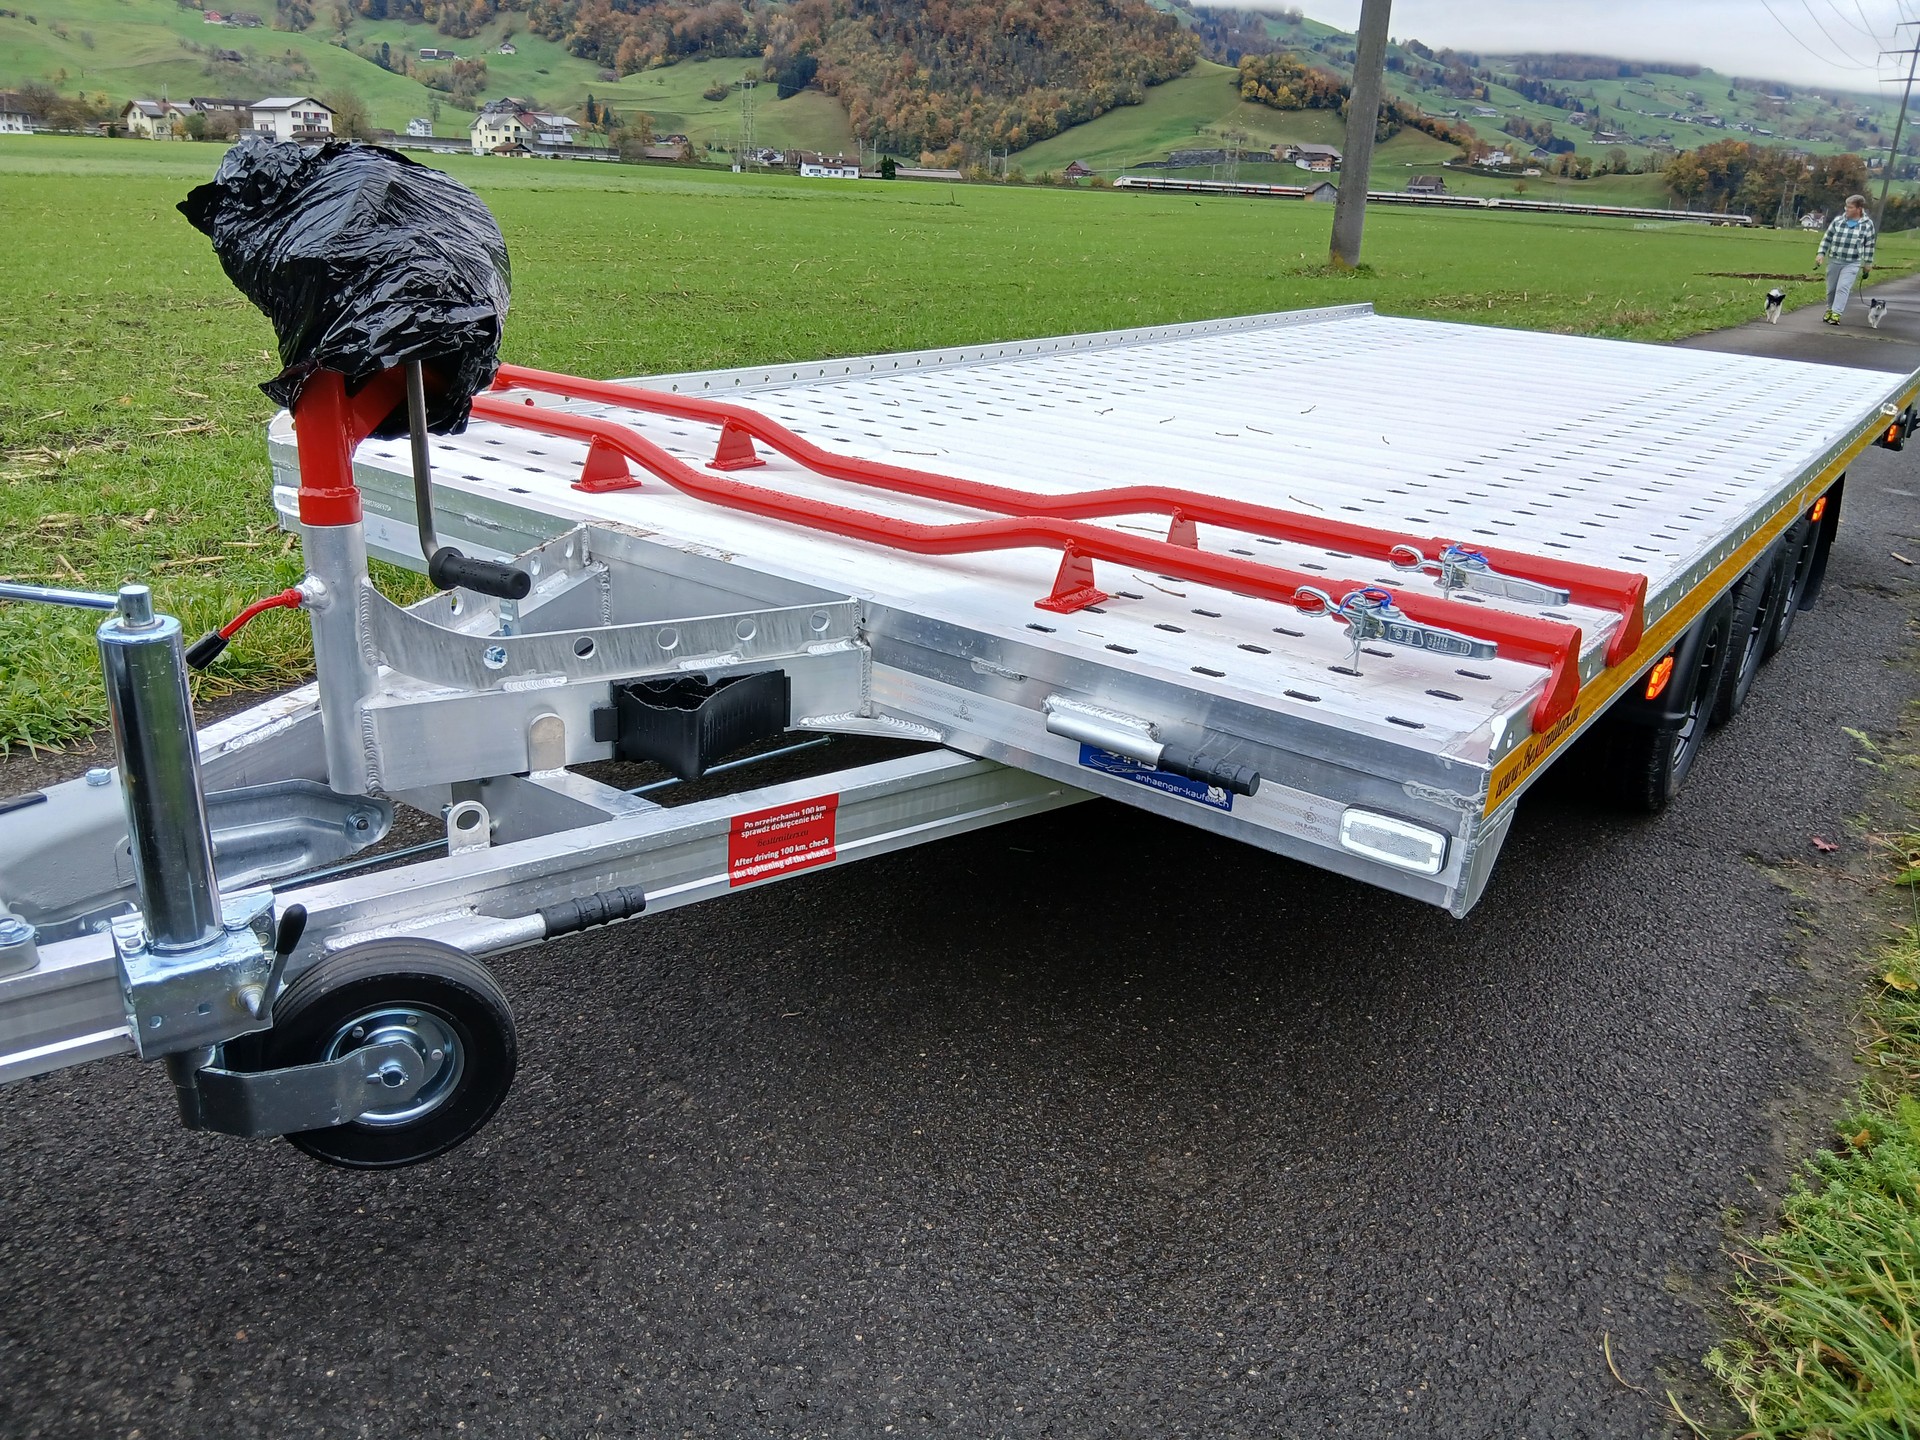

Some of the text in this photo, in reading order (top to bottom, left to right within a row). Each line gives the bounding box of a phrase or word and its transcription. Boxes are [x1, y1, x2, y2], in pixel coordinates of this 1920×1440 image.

[801, 807, 815, 815] 100
[815, 804, 827, 812] km
[734, 858, 753, 867] After
[754, 850, 779, 862] driving
[780, 846, 795, 855] 100
[809, 837, 829, 848] check
[733, 870, 747, 879] the
[747, 861, 785, 876] tightening
[785, 857, 794, 866] of
[793, 854, 805, 863] the
